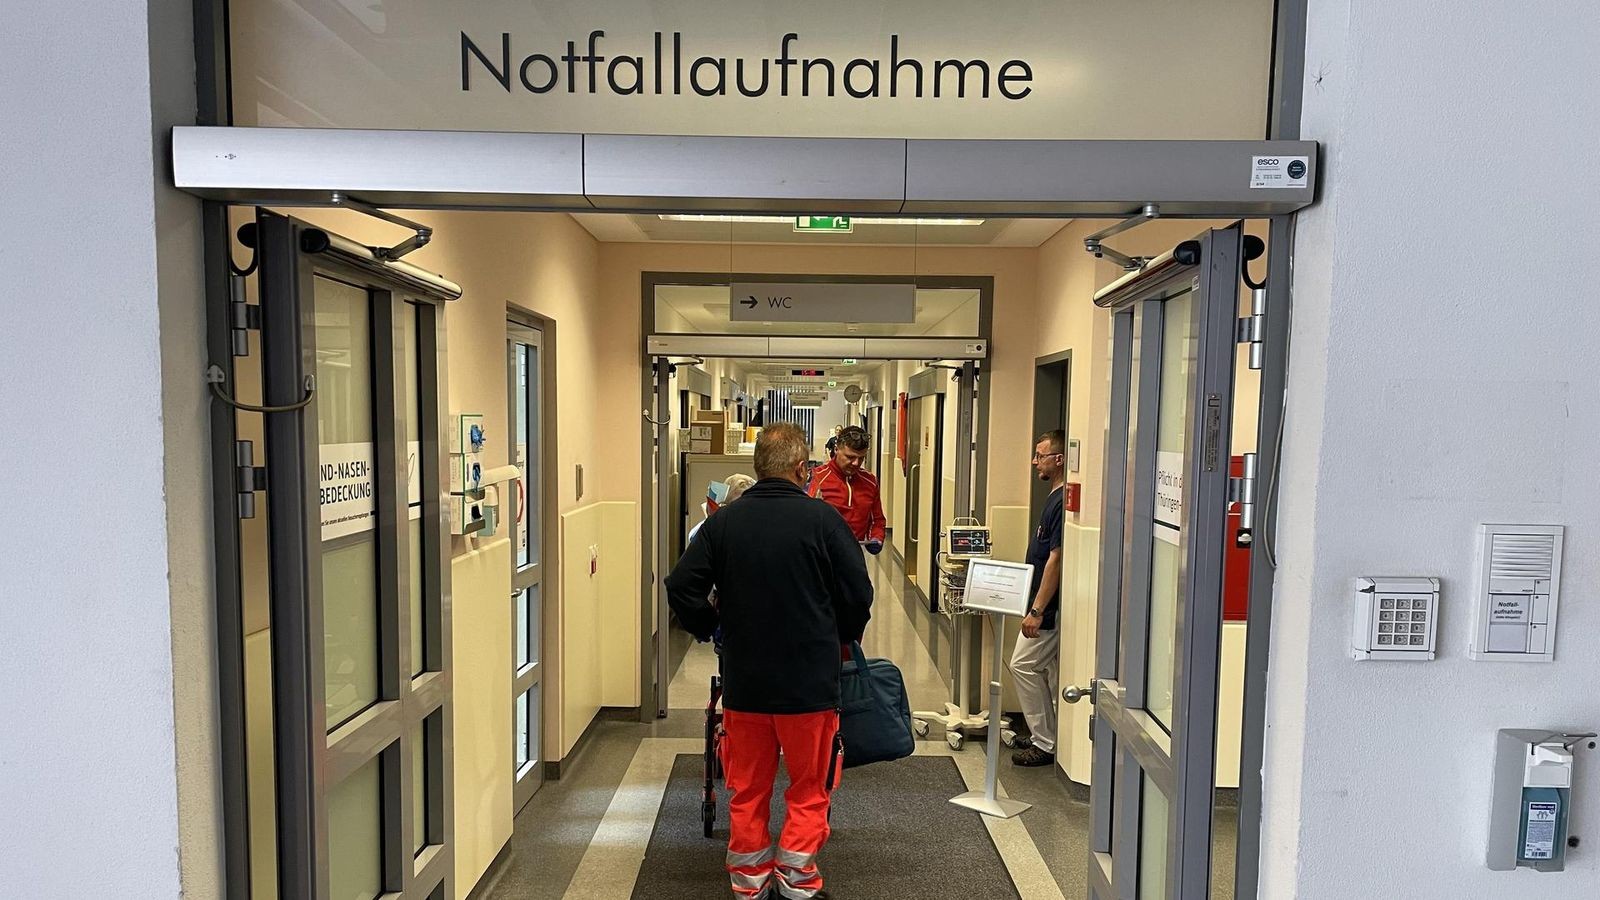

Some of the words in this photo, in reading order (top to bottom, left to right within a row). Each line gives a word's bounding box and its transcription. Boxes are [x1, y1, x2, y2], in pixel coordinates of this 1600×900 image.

[460, 30, 1034, 100] Notfallaufnahme
[767, 296, 793, 309] WC
[320, 482, 371, 506] BEDECKUNG
